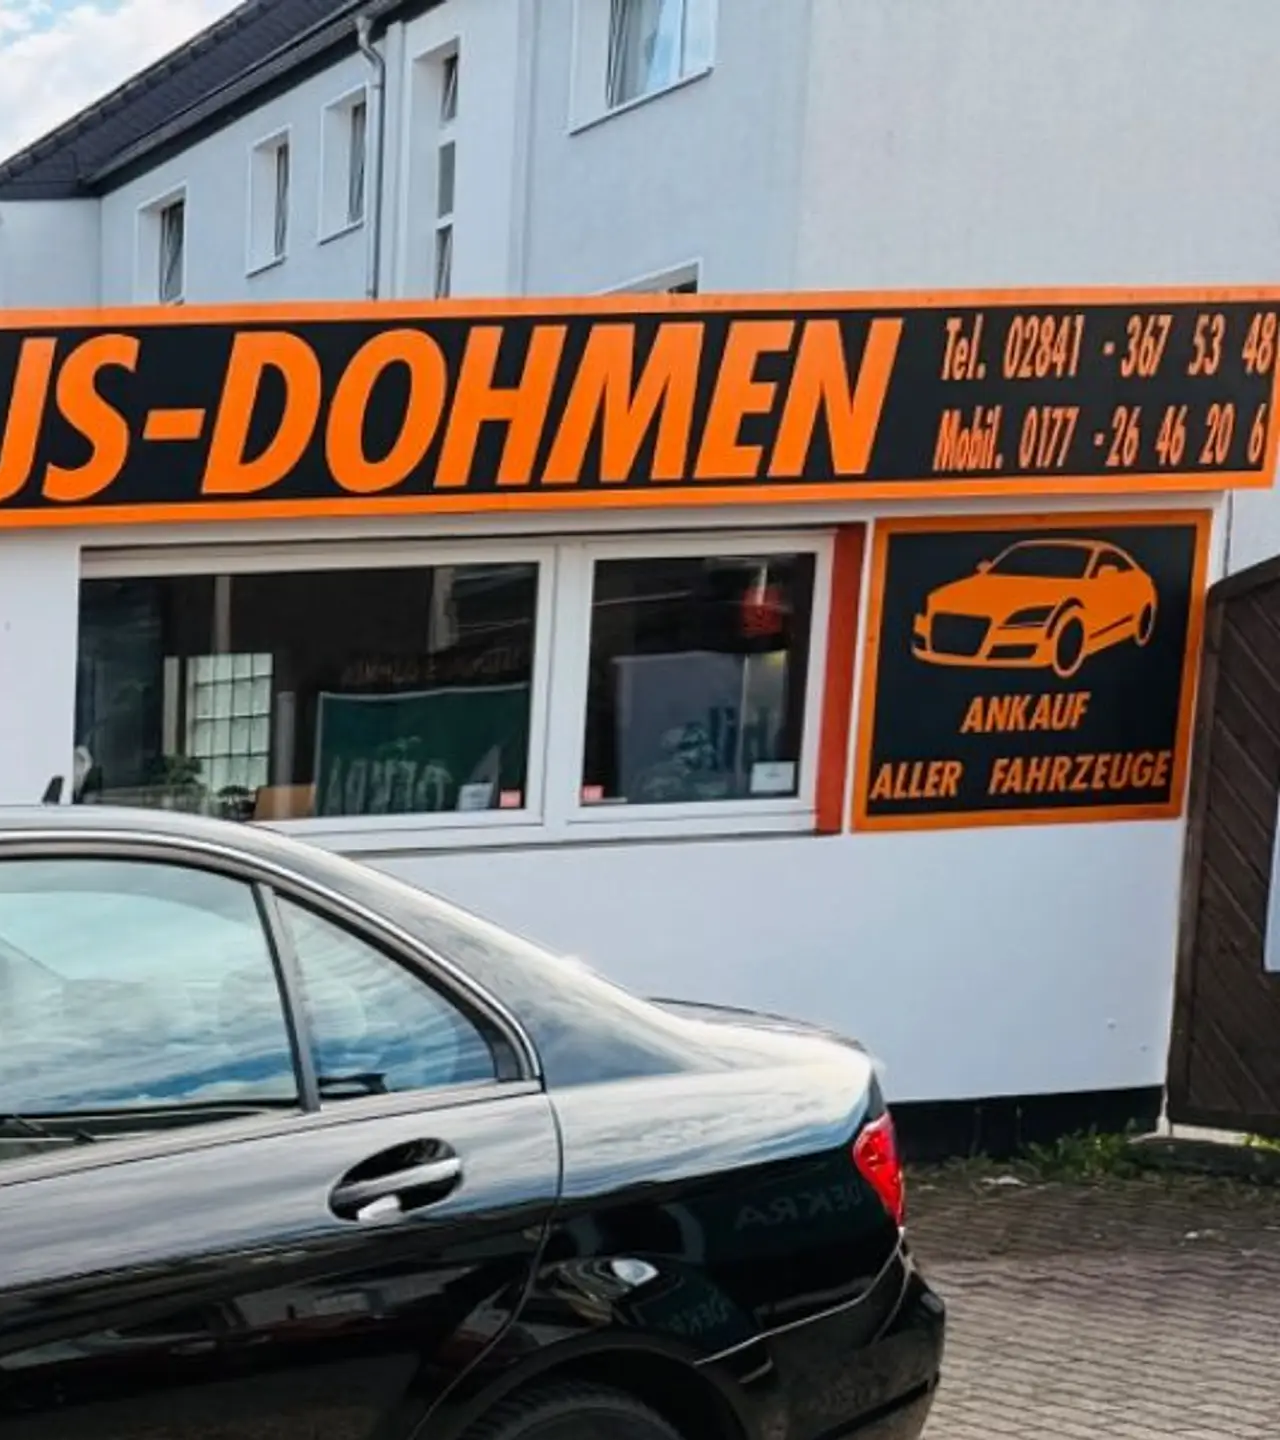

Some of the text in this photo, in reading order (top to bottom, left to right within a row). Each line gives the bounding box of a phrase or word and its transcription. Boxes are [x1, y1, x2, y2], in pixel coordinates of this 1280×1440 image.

[940, 313, 986, 381] Tel.
[1003, 314, 1085, 379] 02841
[1188, 313, 1226, 376] 53
[1242, 311, 1278, 375] 48
[933, 404, 1003, 472] Mobil.
[1018, 405, 1079, 468] 0177
[1156, 404, 1188, 467] 46
[1199, 402, 1235, 466] 20
[1248, 402, 1267, 466] 6
[959, 691, 1092, 734] ANKAUF
[869, 751, 1172, 799] ALLER FAHRZEUGE
